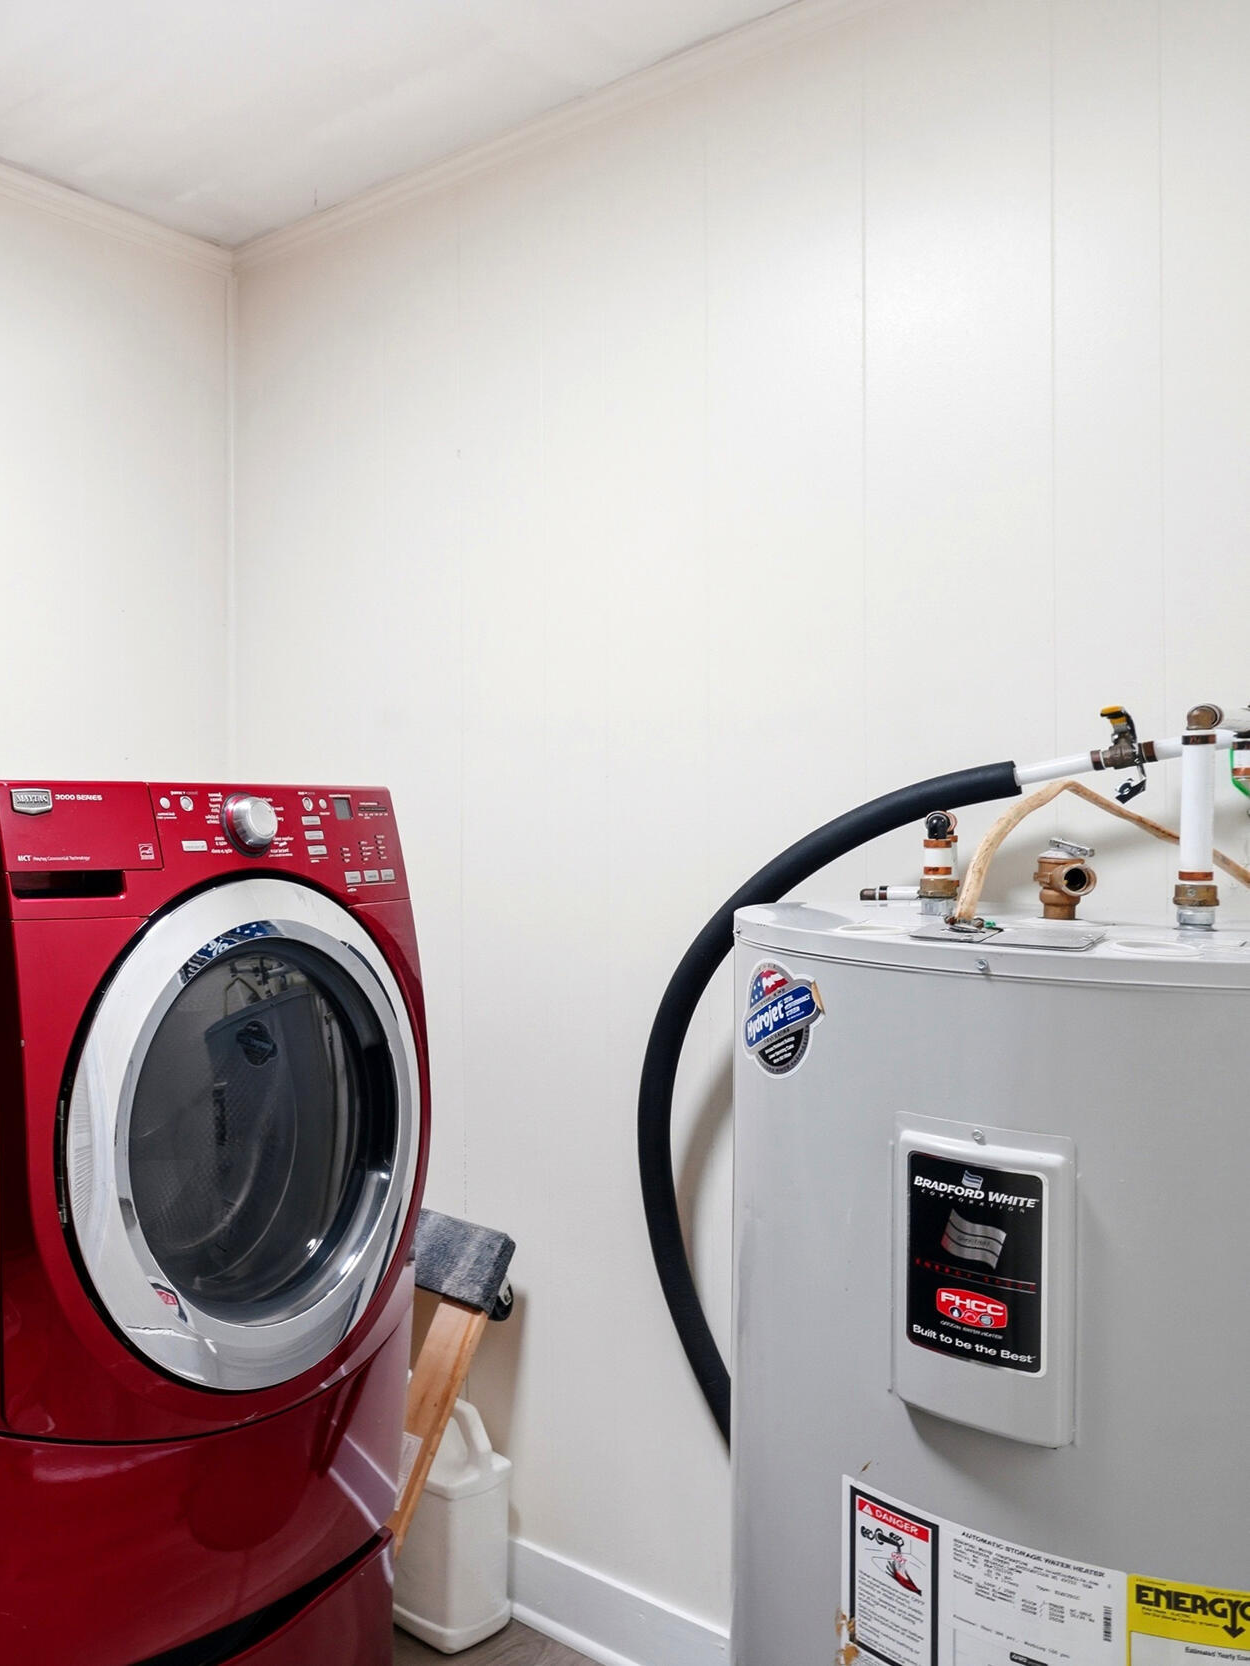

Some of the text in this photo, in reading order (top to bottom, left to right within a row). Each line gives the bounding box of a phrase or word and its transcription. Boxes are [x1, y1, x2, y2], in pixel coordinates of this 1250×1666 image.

[747, 999, 785, 1042] Hydrojet
[914, 1175, 1037, 1209] BRADFORD WHITE
[940, 1292, 1004, 1316] PHCC
[913, 1324, 1034, 1363] Built to be the Best
[875, 1509, 918, 1536] DANGER
[961, 1531, 1004, 1550] AUTOMATIC
[1005, 1546, 1043, 1563] STORAGE
[1043, 1557, 1071, 1570] WATER
[1072, 1565, 1105, 1578] HEATER
